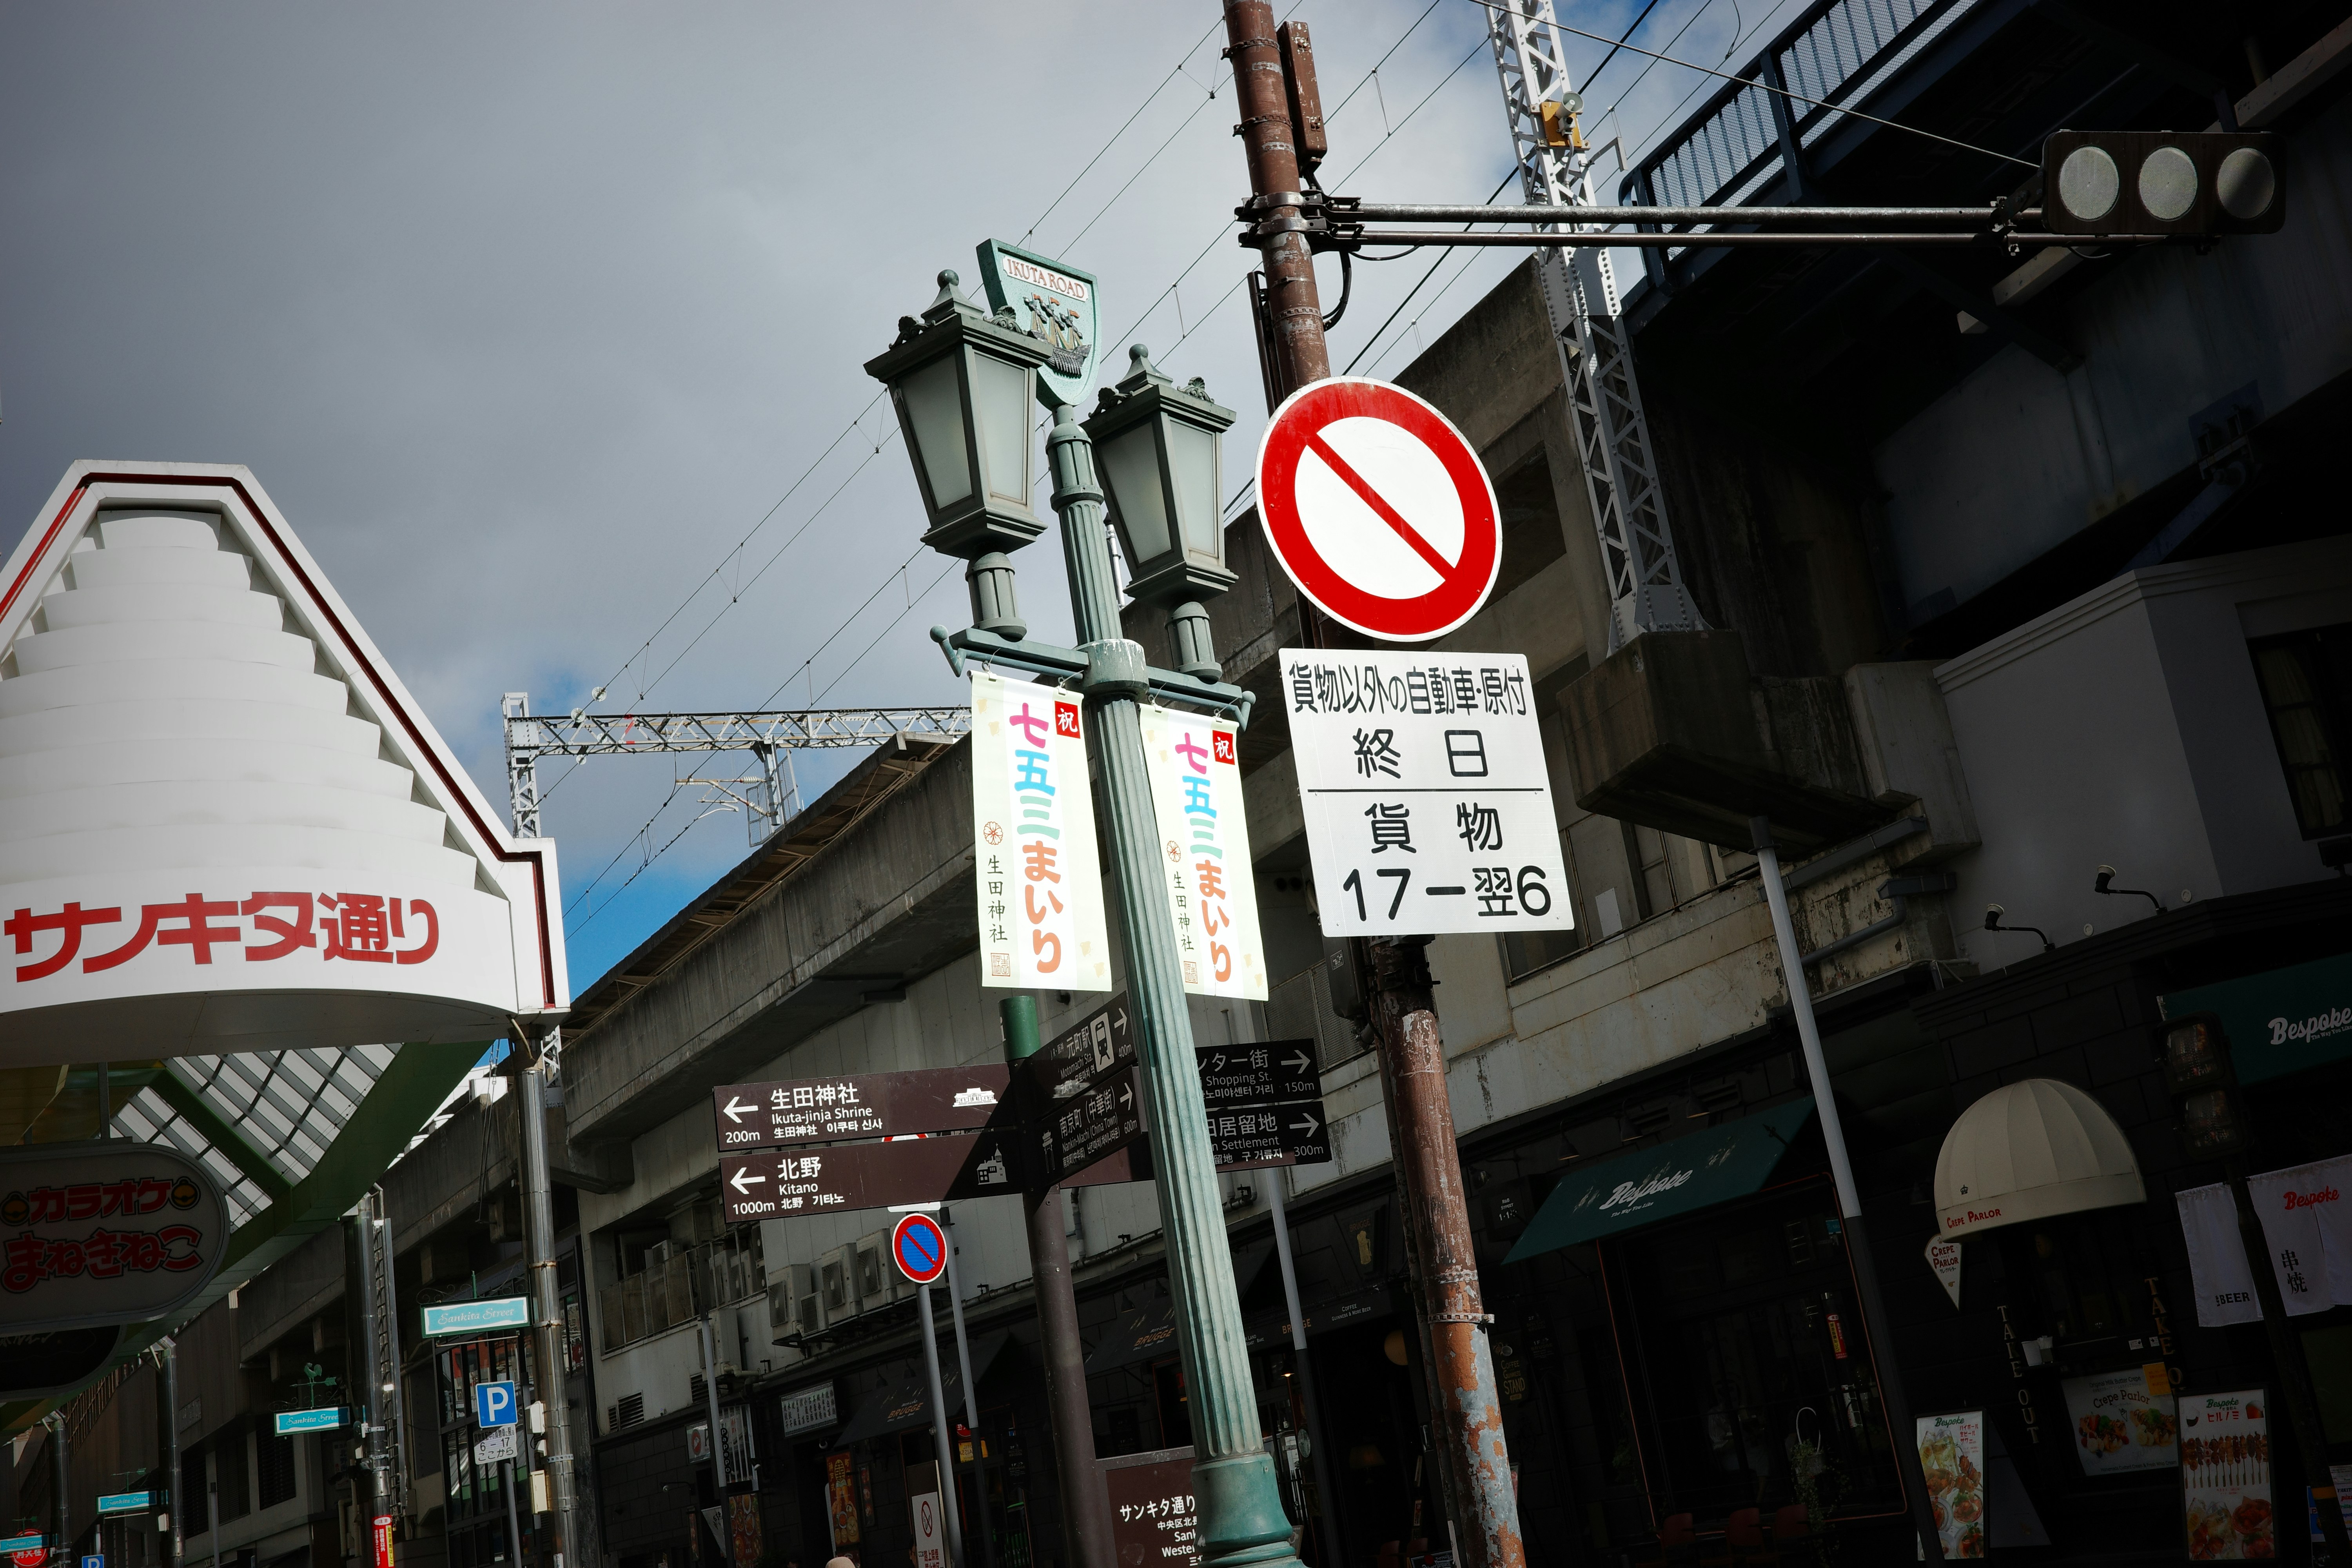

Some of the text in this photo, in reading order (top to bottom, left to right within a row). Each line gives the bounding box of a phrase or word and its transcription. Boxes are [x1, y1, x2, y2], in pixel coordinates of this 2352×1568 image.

[1007, 258, 1085, 299] IKUTA ROAD
[1057, 709, 1078, 733] 祝
[1215, 737, 1234, 760] 祝
[1009, 702, 1064, 974] 七五三まいり
[1175, 732, 1231, 982] 七五三まいり
[987, 855, 1007, 943] 生田神社
[1174, 871, 1194, 952] 生田神社
[4, 891, 439, 983] サンキタ通り
[2268, 1007, 2352, 1045] Bespoke
[1067, 1025, 1091, 1059] 元町駅
[1118, 1044, 1132, 1058] 400m
[1060, 1053, 1093, 1079] Motomachi Sta.
[1206, 1073, 1256, 1087] Shopping
[1258, 1071, 1272, 1081] St.
[1285, 1082, 1314, 1093] 150m
[771, 1082, 859, 1110] 生田神社
[1255, 1084, 1274, 1094] 거리
[772, 1107, 873, 1125] Ikuta-jinja Shrine
[774, 1124, 818, 1139] 生田神社
[827, 1118, 882, 1133] 이쿠타 신사
[1124, 1120, 1137, 1134] 600m
[725, 1131, 760, 1143] 200m
[1062, 1128, 1090, 1153] Nankin-Machi
[1222, 1136, 1279, 1151] Settlement
[1242, 1148, 1282, 1162] 구 거류지
[1294, 1145, 1323, 1156] 300m
[777, 1156, 821, 1181] 北野
[779, 1183, 818, 1196] Kitano
[1599, 1170, 1693, 1210] Bespoke
[2283, 1186, 2339, 1210] Bespoke
[29, 1178, 172, 1224] カラオケ
[733, 1201, 775, 1215] 1000m
[781, 1197, 803, 1210] 北野
[813, 1194, 844, 1205] 기타노
[2, 1229, 201, 1292] まねきねこ
[2281, 1250, 2307, 1294] 串焼
[2220, 1292, 2250, 1304] BEER
[438, 1308, 515, 1325] Sankita Street
[2144, 1276, 2176, 1356] TAKE
[1282, 1318, 1312, 1334] BRGE
[1134, 1327, 1175, 1347] BRUGGE
[1997, 1304, 2023, 1378] TAKE
[1503, 1377, 1525, 1395] STAND
[487, 1387, 508, 1421] P
[2093, 1390, 2150, 1408] Crepe Parlor
[2206, 1397, 2239, 1409] Bespoke
[888, 1402, 924, 1419] BRUGGE
[2018, 1388, 2039, 1444] OUT
[2208, 1411, 2239, 1422] ヒルノミ
[286, 1417, 316, 1425] Sankita
[1935, 1416, 1964, 1428] Bespoke
[478, 1447, 514, 1461] ここから
[1120, 1495, 1195, 1522] サンキタ通り
